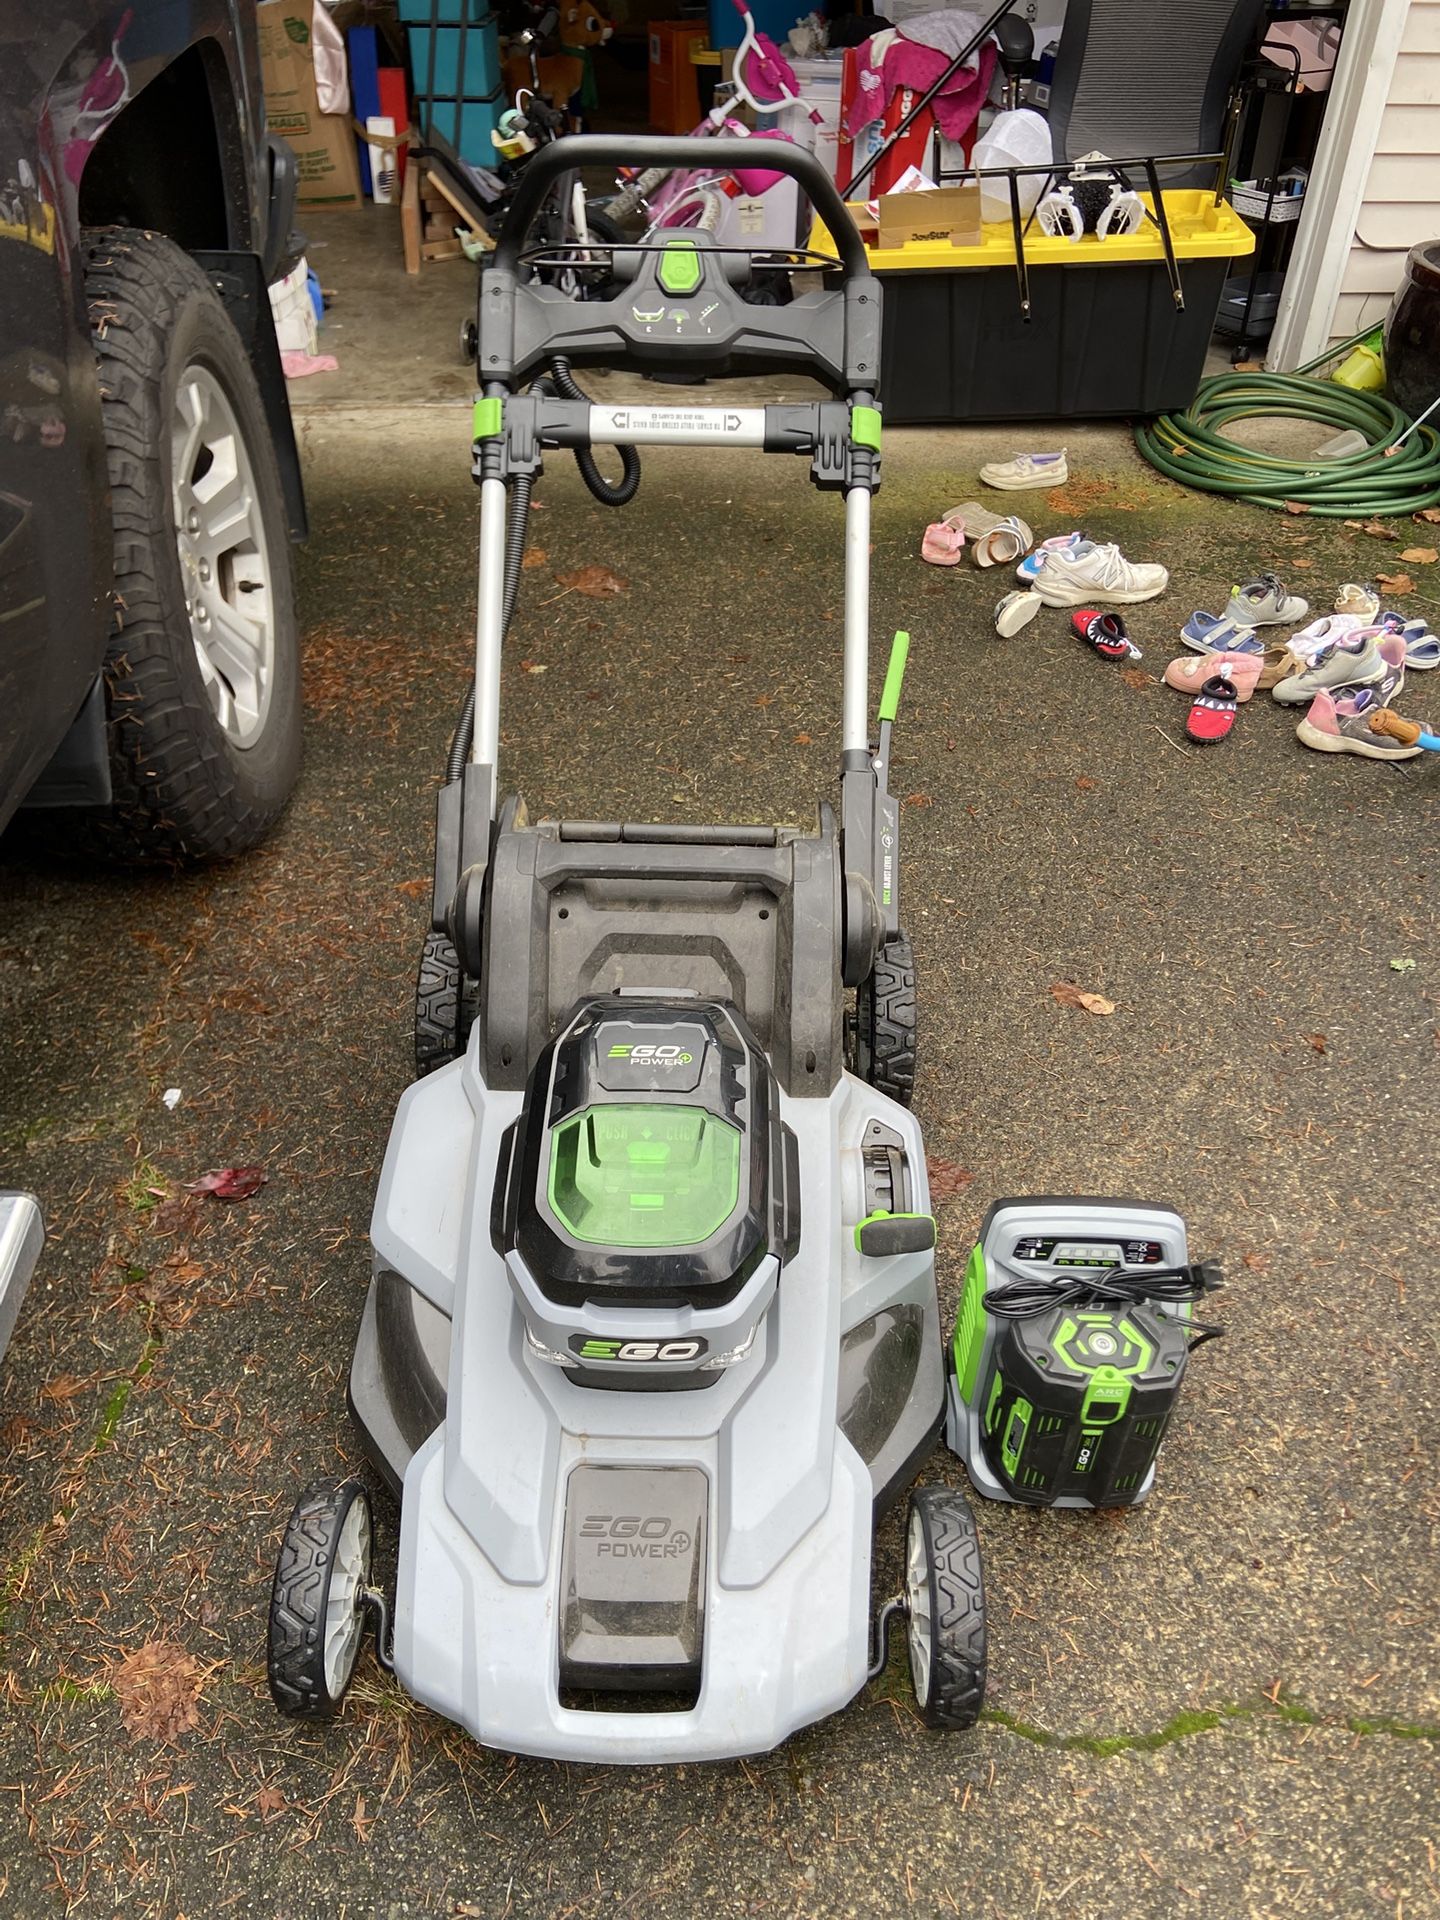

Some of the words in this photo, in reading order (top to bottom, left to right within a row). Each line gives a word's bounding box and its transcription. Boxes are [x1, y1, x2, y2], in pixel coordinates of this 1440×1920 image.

[607, 1045, 681, 1058] EGO
[580, 1340, 699, 1361] EGO
[579, 1515, 672, 1538] EGO
